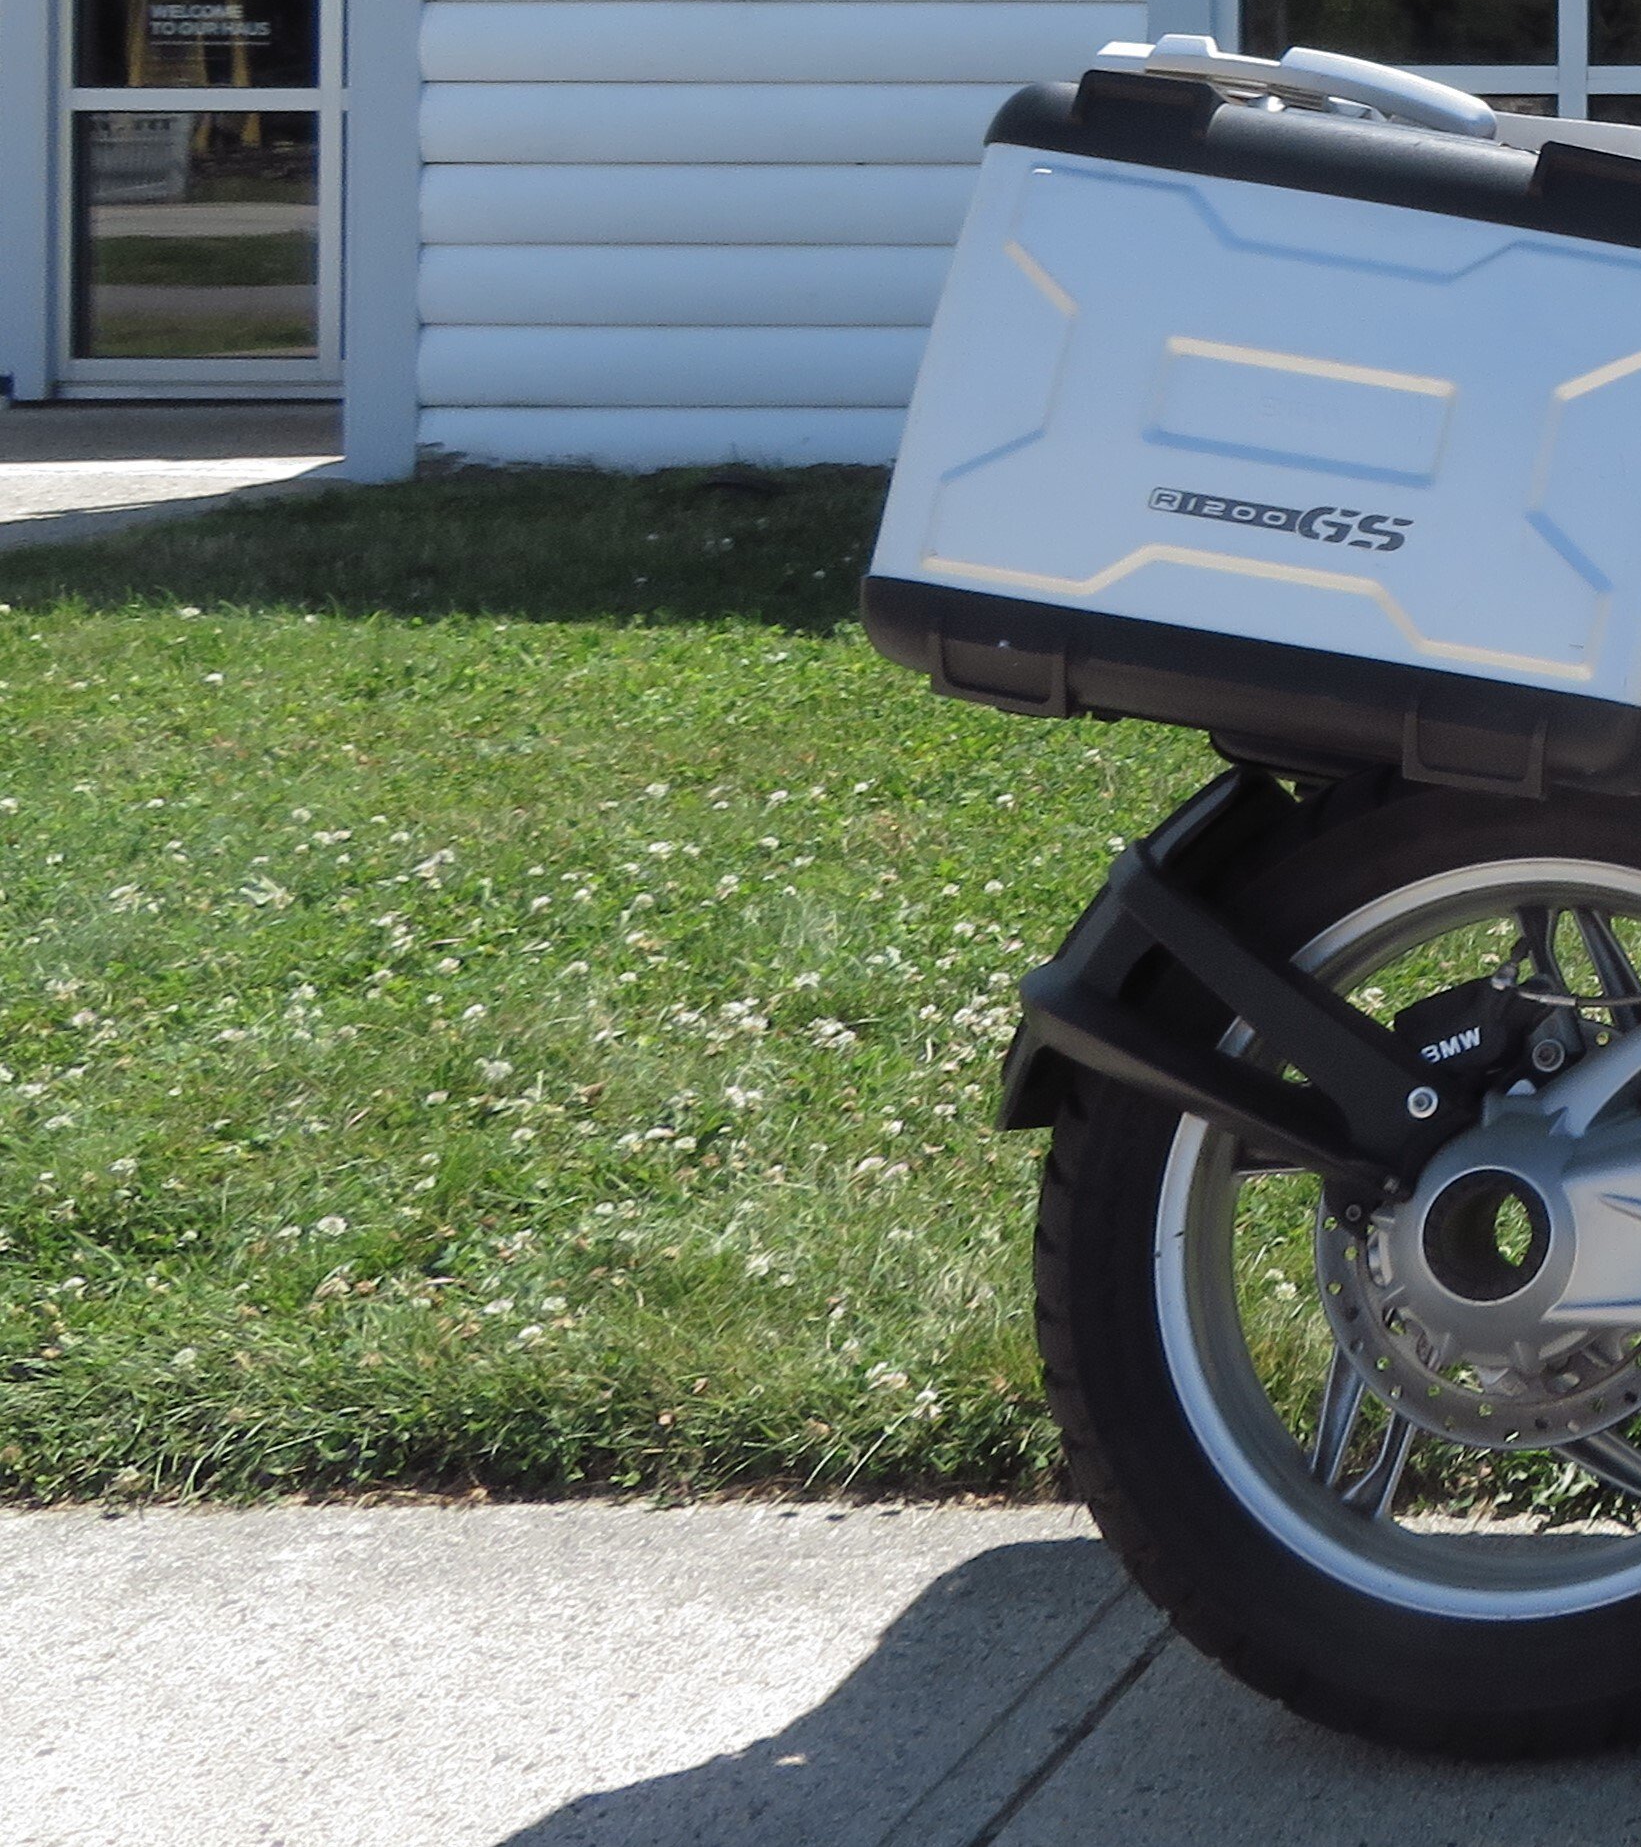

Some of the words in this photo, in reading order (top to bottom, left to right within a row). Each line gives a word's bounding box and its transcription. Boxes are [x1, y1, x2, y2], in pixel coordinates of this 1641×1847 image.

[150, 4, 244, 19] WELCOME
[150, 21, 177, 36] TO
[178, 21, 220, 36] OUR
[222, 21, 272, 36] HAUS
[1420, 1025, 1481, 1064] BMW
